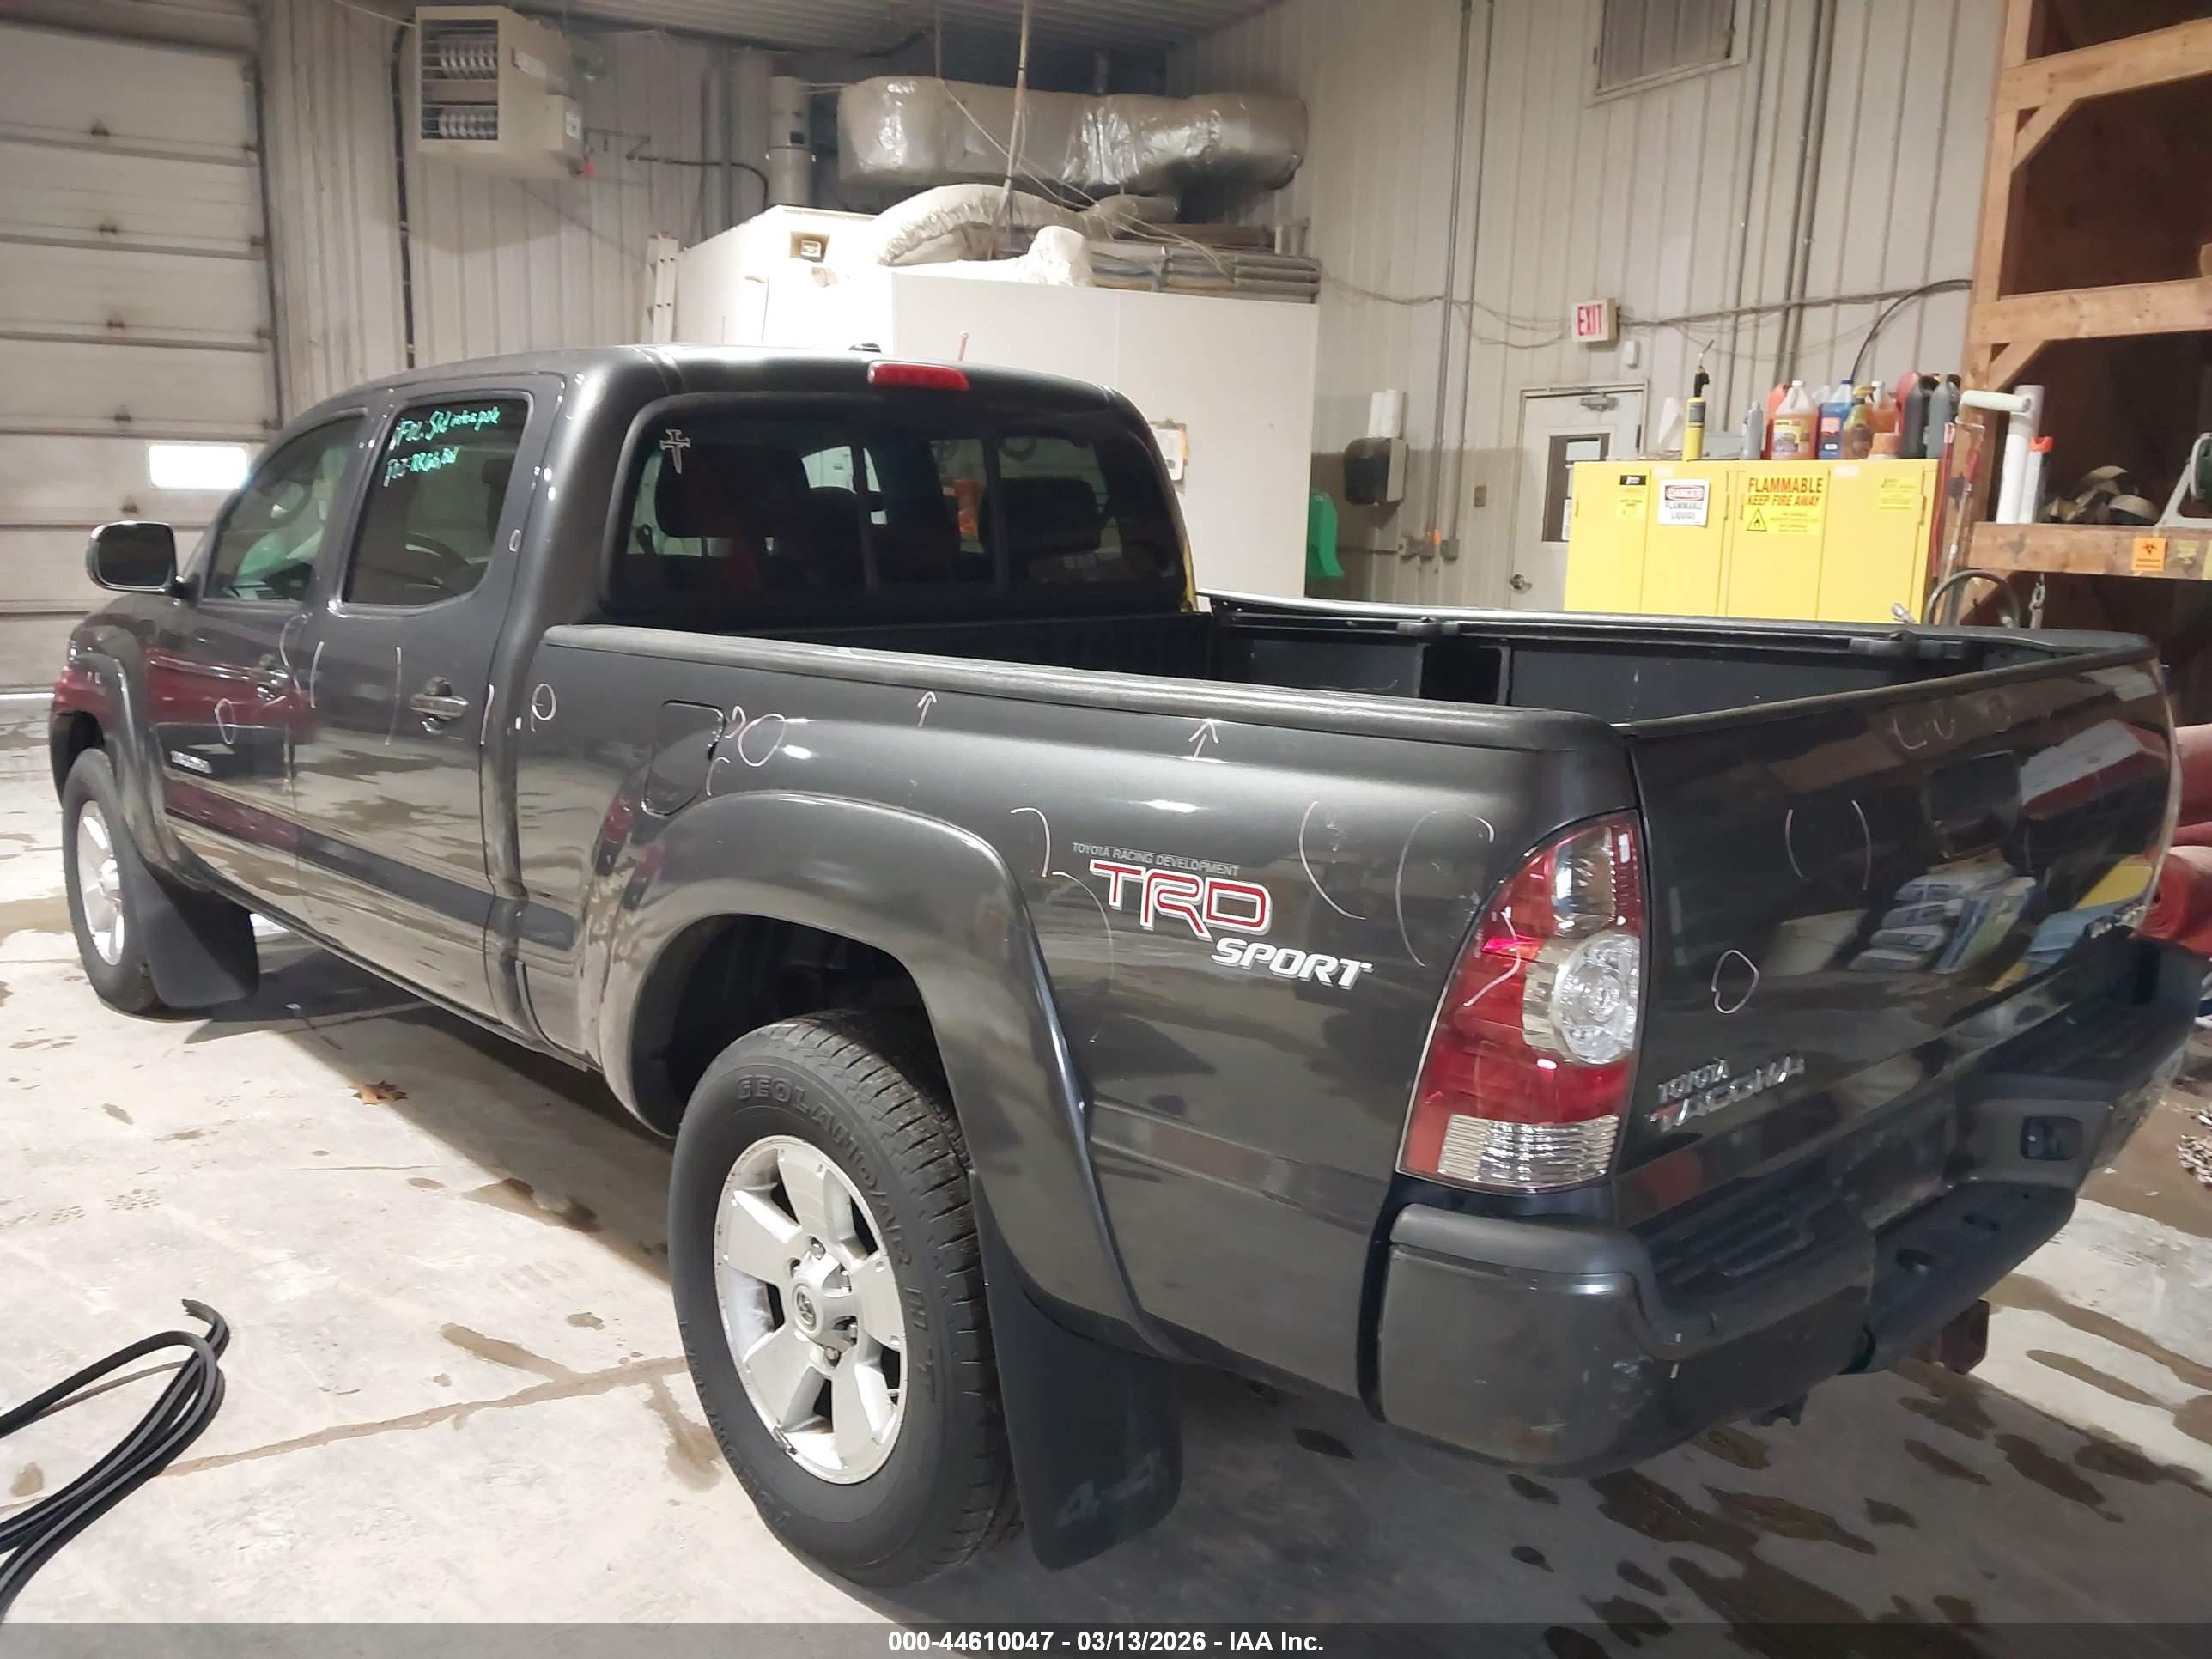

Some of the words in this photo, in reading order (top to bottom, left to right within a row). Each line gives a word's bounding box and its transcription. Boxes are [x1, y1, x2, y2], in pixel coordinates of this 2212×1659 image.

[1577, 303, 1603, 336] EXIT
[1747, 477, 1823, 493] FLAMMABLE
[1747, 495, 1770, 506] KEEP
[1771, 495, 1793, 506] FIRE
[1793, 495, 1820, 507] AWAY
[1073, 842, 1110, 857] TOYOTA
[1113, 848, 1154, 864] RACING
[1155, 854, 1239, 877] DEVELOPMENT
[1090, 859, 1272, 943] TRD
[1211, 937, 1374, 990] SPORT
